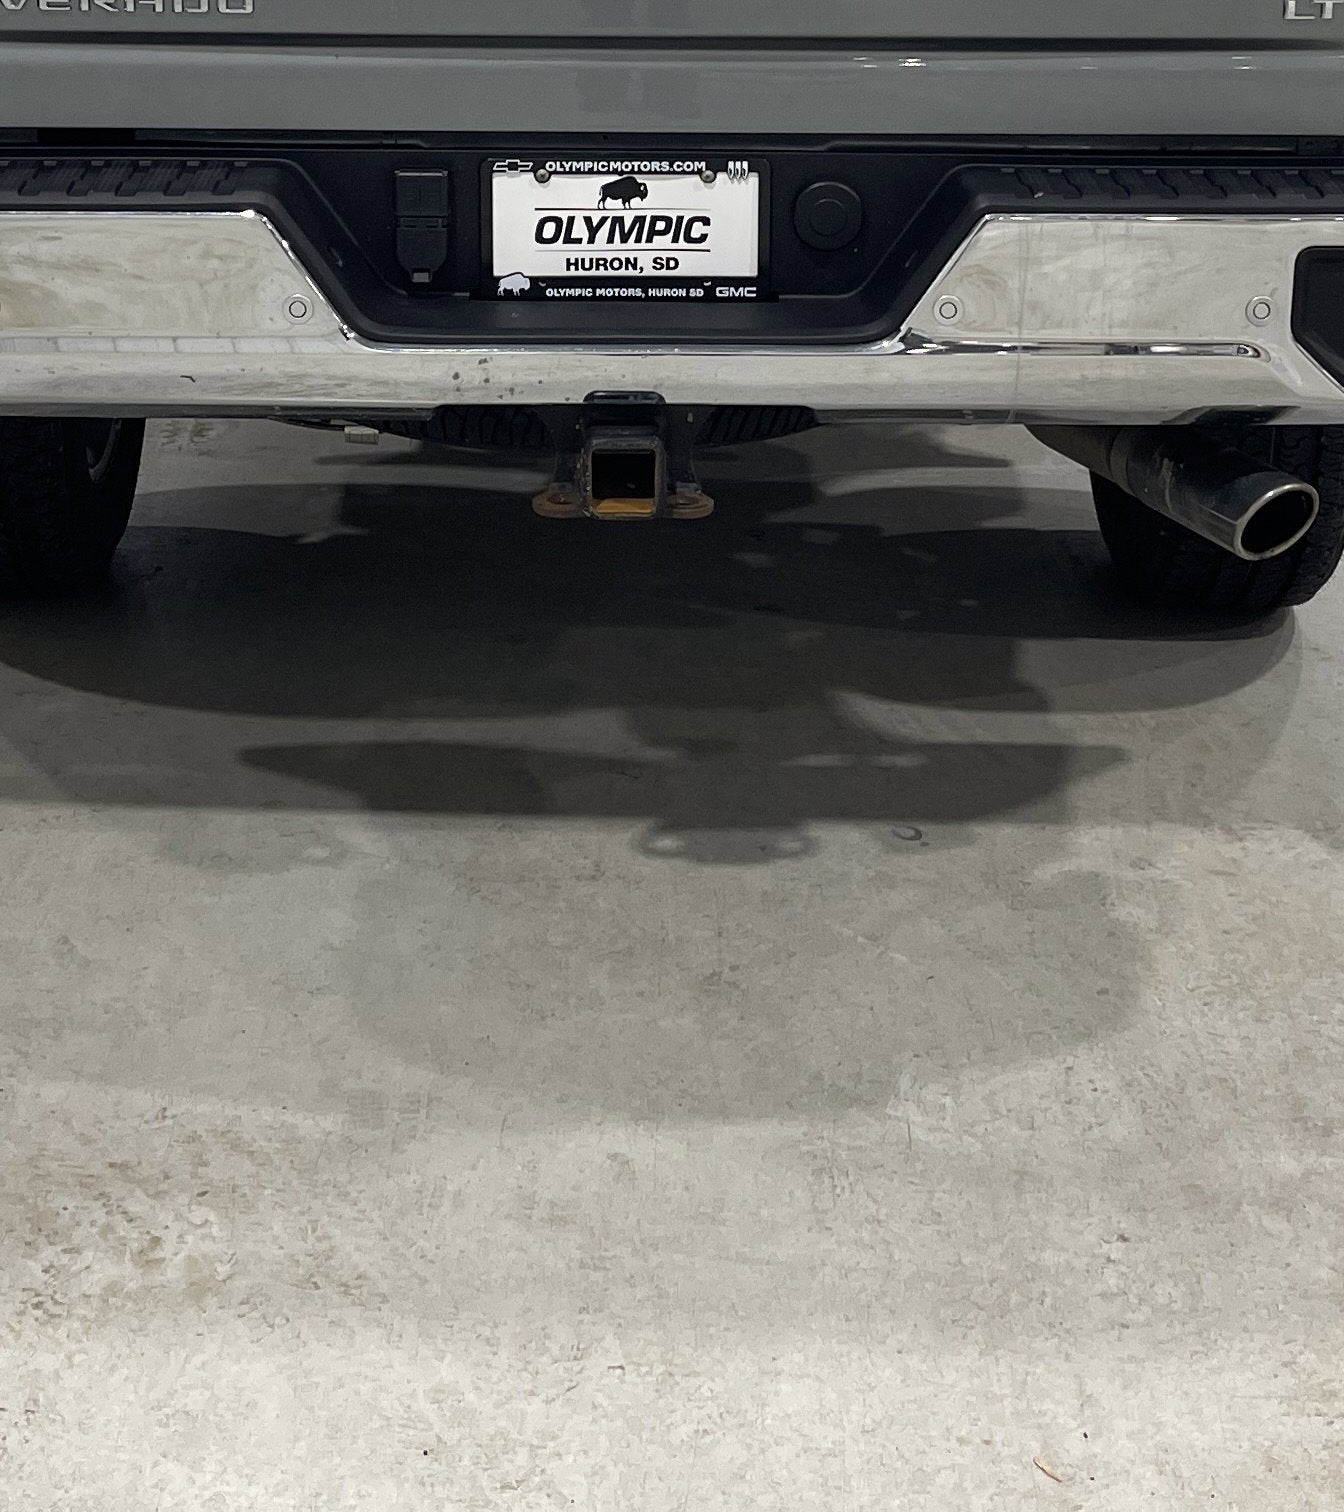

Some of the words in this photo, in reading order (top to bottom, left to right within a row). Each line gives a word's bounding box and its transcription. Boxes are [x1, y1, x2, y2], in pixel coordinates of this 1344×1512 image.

[1284, 0, 1344, 20] LT
[534, 214, 711, 245] OLYMPIC
[565, 256, 644, 274] HURON,
[651, 256, 680, 271] SD
[545, 288, 593, 297] OLYMPIC
[595, 287, 646, 298] MOTORS,
[648, 288, 687, 297] HURON
[689, 288, 704, 297] SD
[715, 286, 757, 297] GMC
